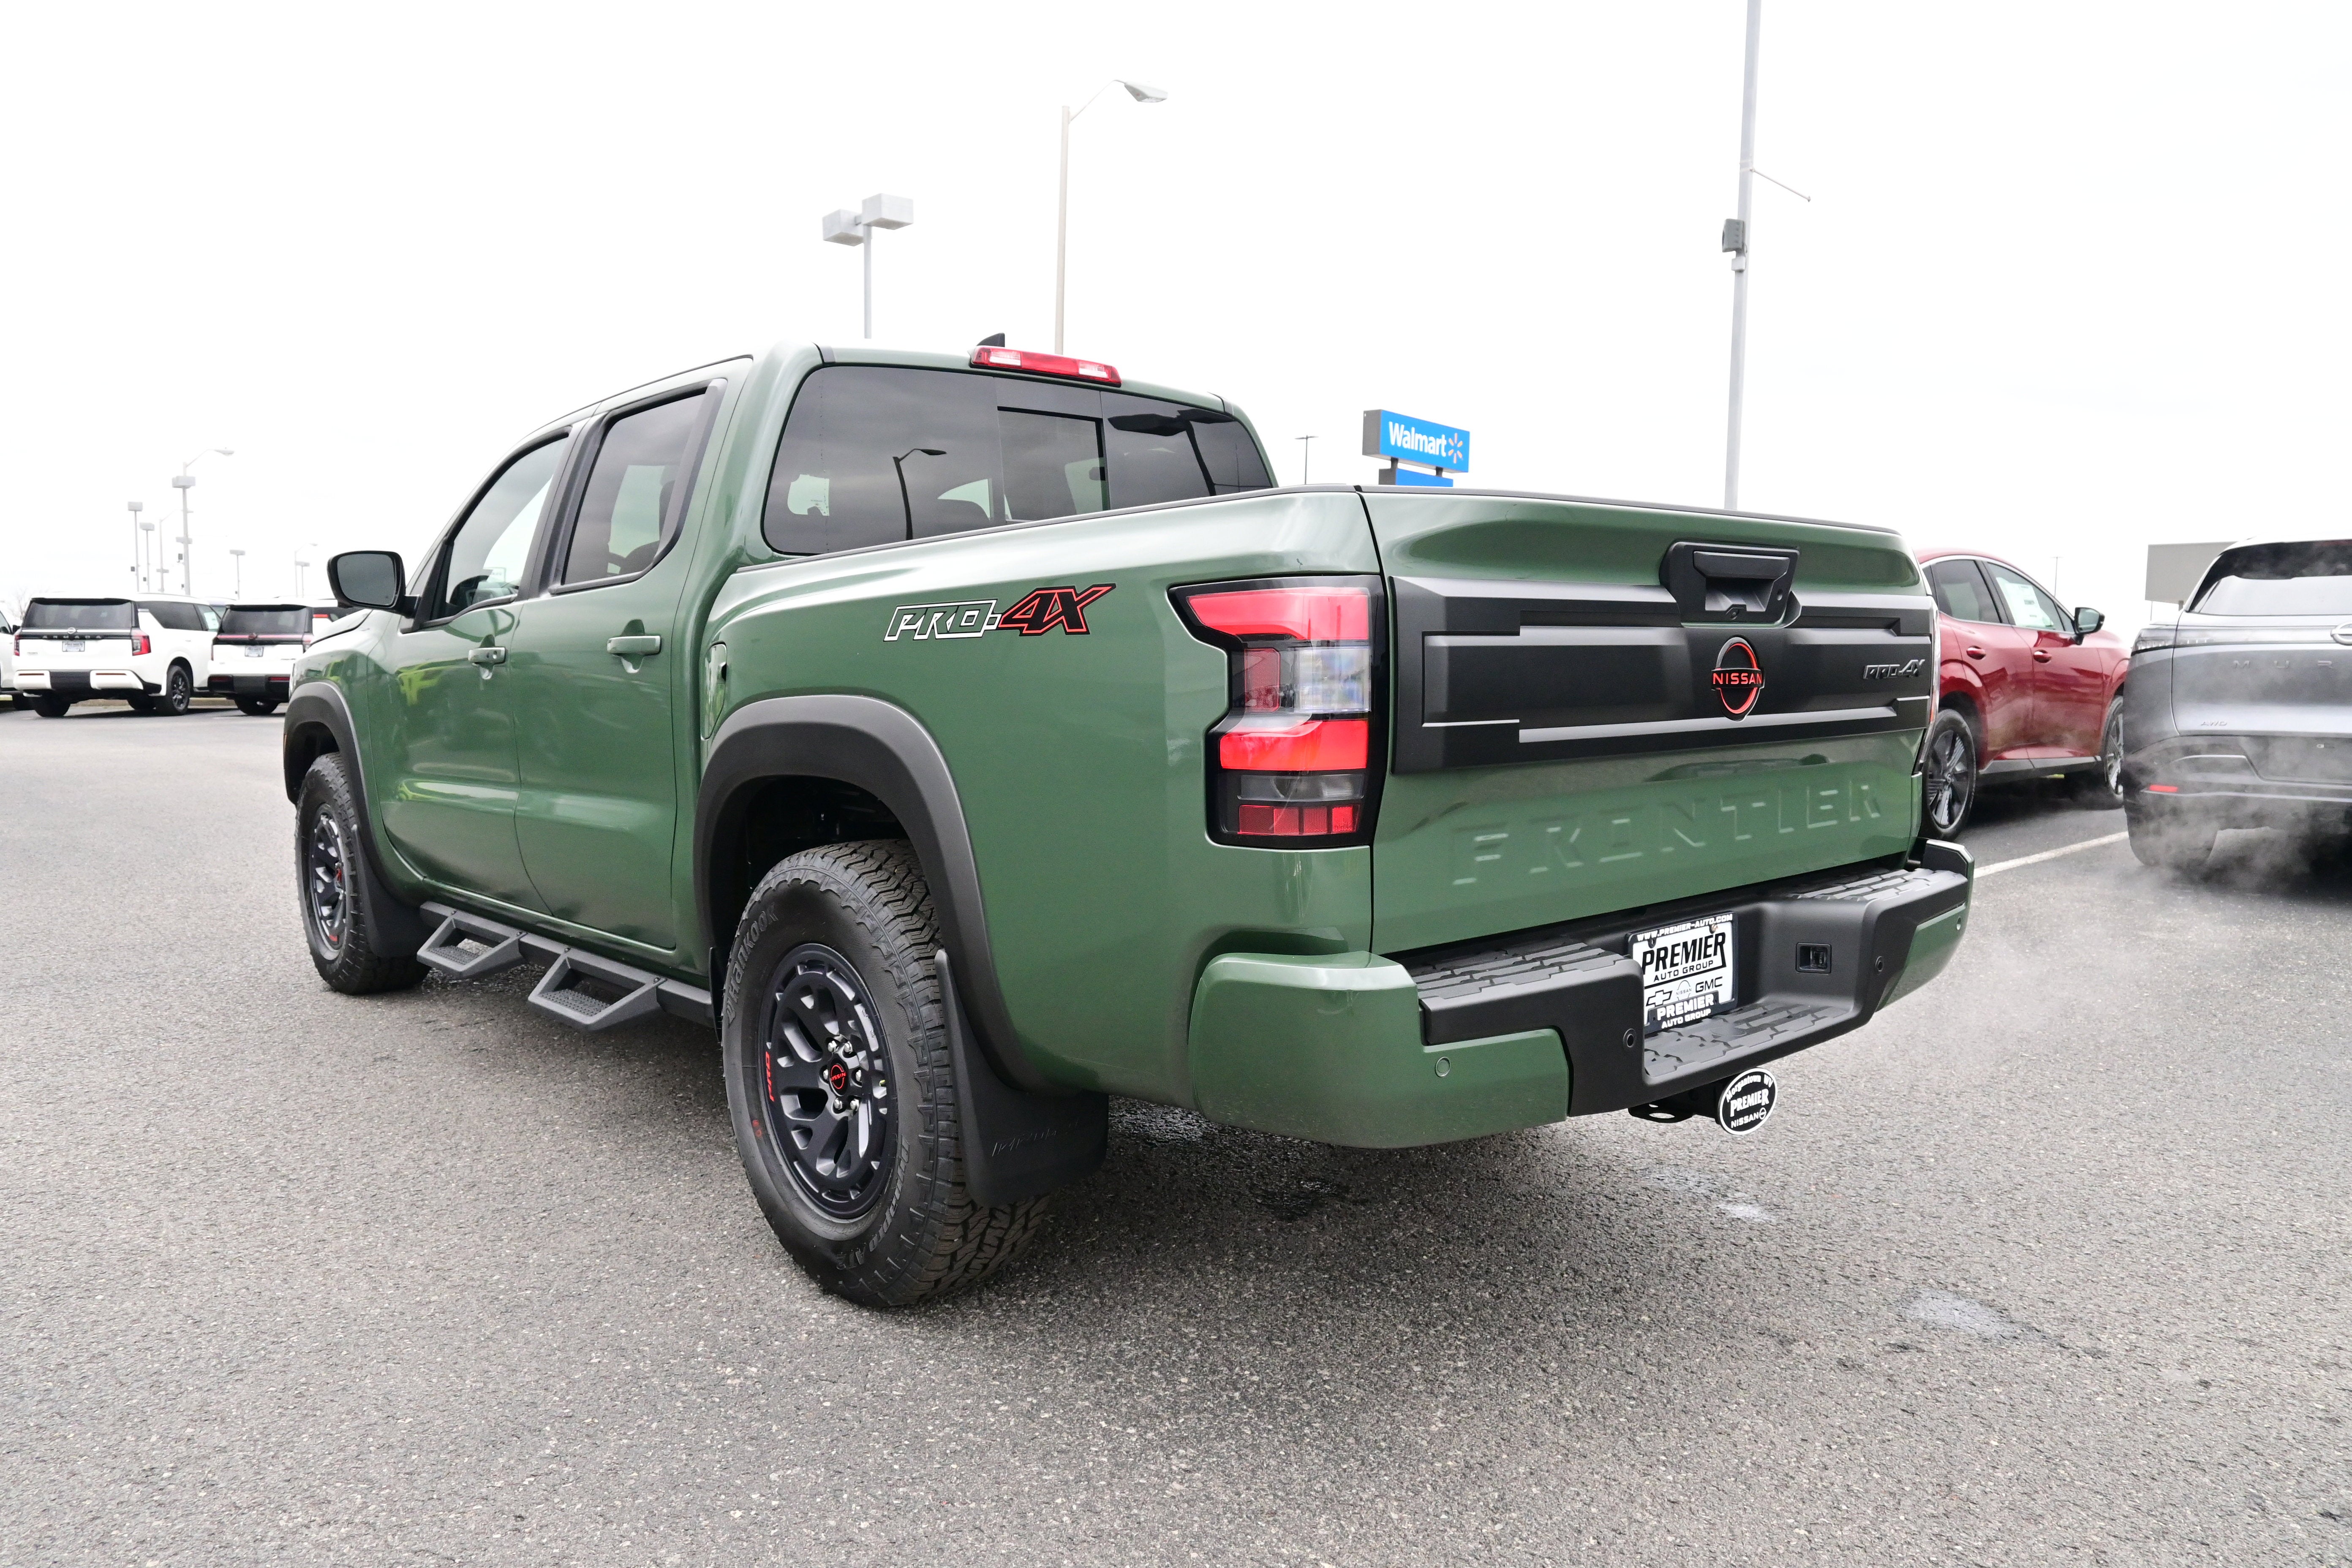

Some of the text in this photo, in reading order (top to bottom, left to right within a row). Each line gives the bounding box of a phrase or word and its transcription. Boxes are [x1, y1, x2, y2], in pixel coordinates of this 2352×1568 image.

[1389, 421, 1447, 457] Walmart
[1712, 672, 1762, 685] NISSAN
[1452, 779, 1881, 885] FRONTIER
[1637, 914, 1733, 941] WWW.PREMIER-AUTO.COM
[1642, 932, 1727, 975] PREMIER
[1653, 960, 1713, 982] AUTO GROUP
[1696, 976, 1723, 993] GMC
[1657, 994, 1714, 1021] PREMIER
[1661, 1008, 1711, 1029] AUTO GROUP
[1726, 1074, 1773, 1103] Morgantown WV
[1730, 1089, 1769, 1117] PREMIER
[1731, 1112, 1759, 1128] NISSAN
